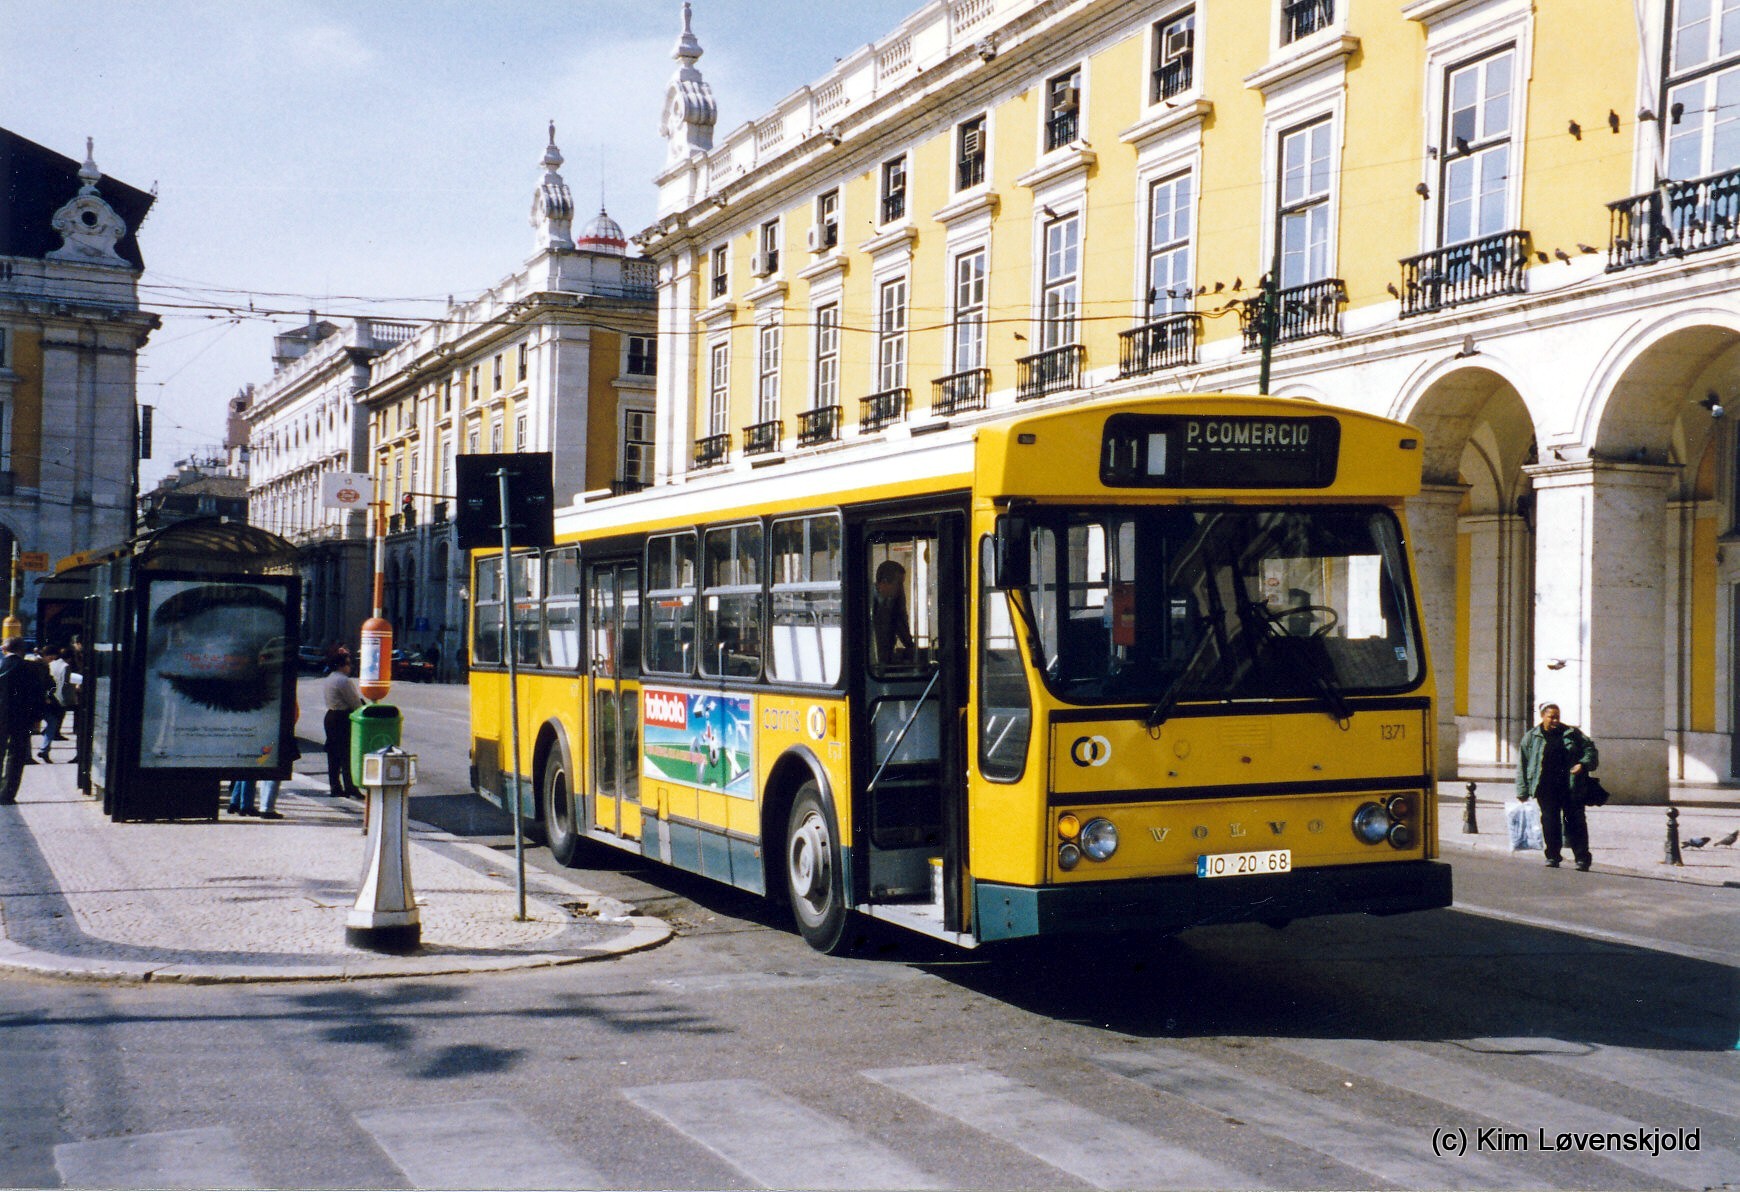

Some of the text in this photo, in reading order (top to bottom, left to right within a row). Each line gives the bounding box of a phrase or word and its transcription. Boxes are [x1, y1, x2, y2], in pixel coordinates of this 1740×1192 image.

[1187, 421, 1310, 446] P.COMERCIO
[644, 691, 685, 724] totobola
[1380, 724, 1406, 740] 1371
[1149, 819, 1325, 842] VOLVO
